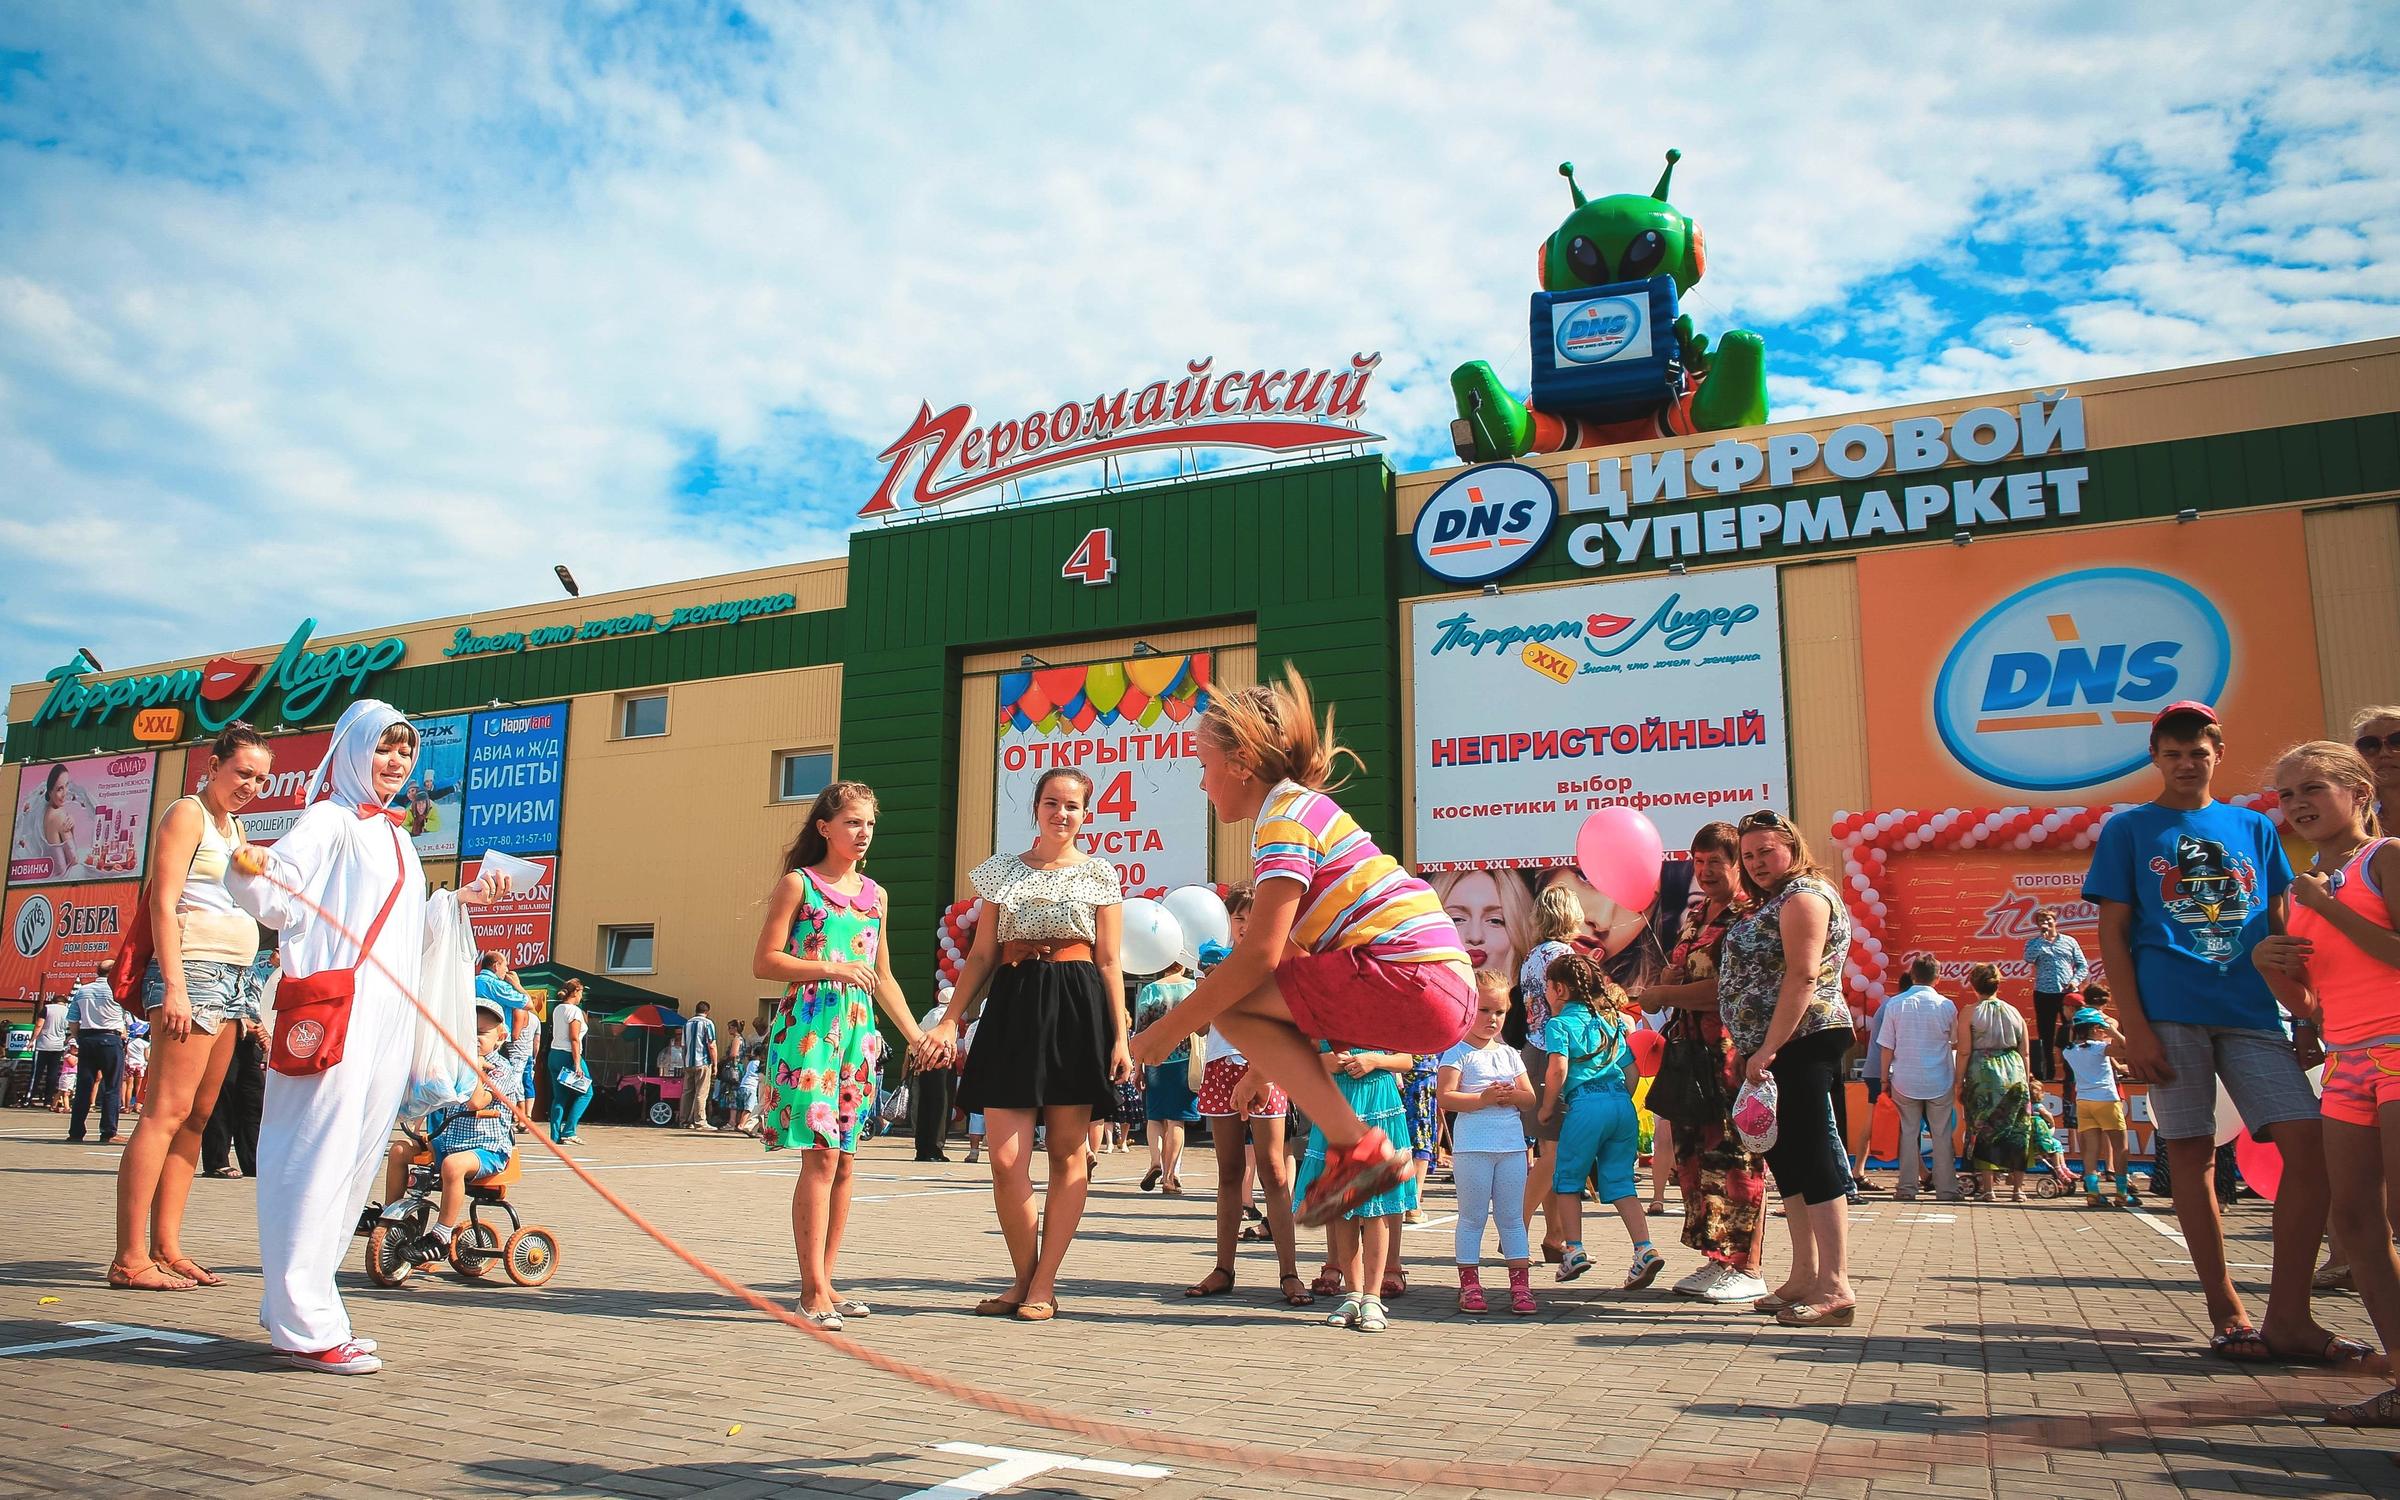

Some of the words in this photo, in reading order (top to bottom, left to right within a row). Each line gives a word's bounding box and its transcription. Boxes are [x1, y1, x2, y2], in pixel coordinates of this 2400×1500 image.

[1569, 315, 1628, 338] DNS
[857, 352, 1388, 518] Первомайский
[1567, 388, 2088, 518] ЦИФРОВОЙ
[1432, 496, 1537, 543] DNS
[1568, 466, 2089, 568] СУПЕРМАРКЕТ
[1062, 528, 1117, 585] 4
[530, 624, 575, 648] что
[577, 612, 653, 640] хочет
[653, 592, 796, 634] женщина
[1430, 611, 1583, 656] Парфюм
[1584, 593, 1760, 657] Лидер
[32, 652, 202, 729] Парфюм
[194, 616, 408, 732] Лидер
[1531, 649, 1570, 679] XXL
[1981, 640, 2185, 713] DNS
[142, 714, 176, 735] XXL
[1431, 709, 1767, 768] НЕПРИСТОЙНЫЙ
[473, 744, 512, 763] АВИА
[516, 747, 525, 758] и
[528, 738, 559, 759] Ж/Д
[1003, 730, 1199, 772] ОТКРЫТИЕ
[111, 759, 144, 775] CAMAY
[470, 760, 558, 790] БИЛЕТЫ
[1557, 775, 1633, 795] выбор
[469, 799, 555, 828] ТУРИЗМ
[1432, 799, 1556, 820] косметики
[1564, 798, 1579, 811] и
[1586, 788, 1754, 811] парфюмерии
[243, 816, 285, 833] ОРОШЕЙ
[475, 836, 514, 848] 33-77-80,
[516, 833, 552, 845] 21-57-10
[11, 865, 50, 876] НОВИНКА
[1422, 862, 1448, 874] XXL
[1453, 861, 1479, 872] XXL
[1485, 859, 1511, 871] XXL
[1517, 858, 1544, 869] XXL
[1550, 856, 1577, 867] XXL
[2016, 874, 2087, 886] ТОРГОВЫ
[56, 901, 120, 939] ЗЕБРА
[473, 924, 505, 937] только
[507, 924, 513, 939] у
[515, 923, 533, 936] нас
[62, 943, 81, 954] ДОМ
[83, 941, 109, 952] ОБУВИ
[515, 941, 545, 966] 30%
